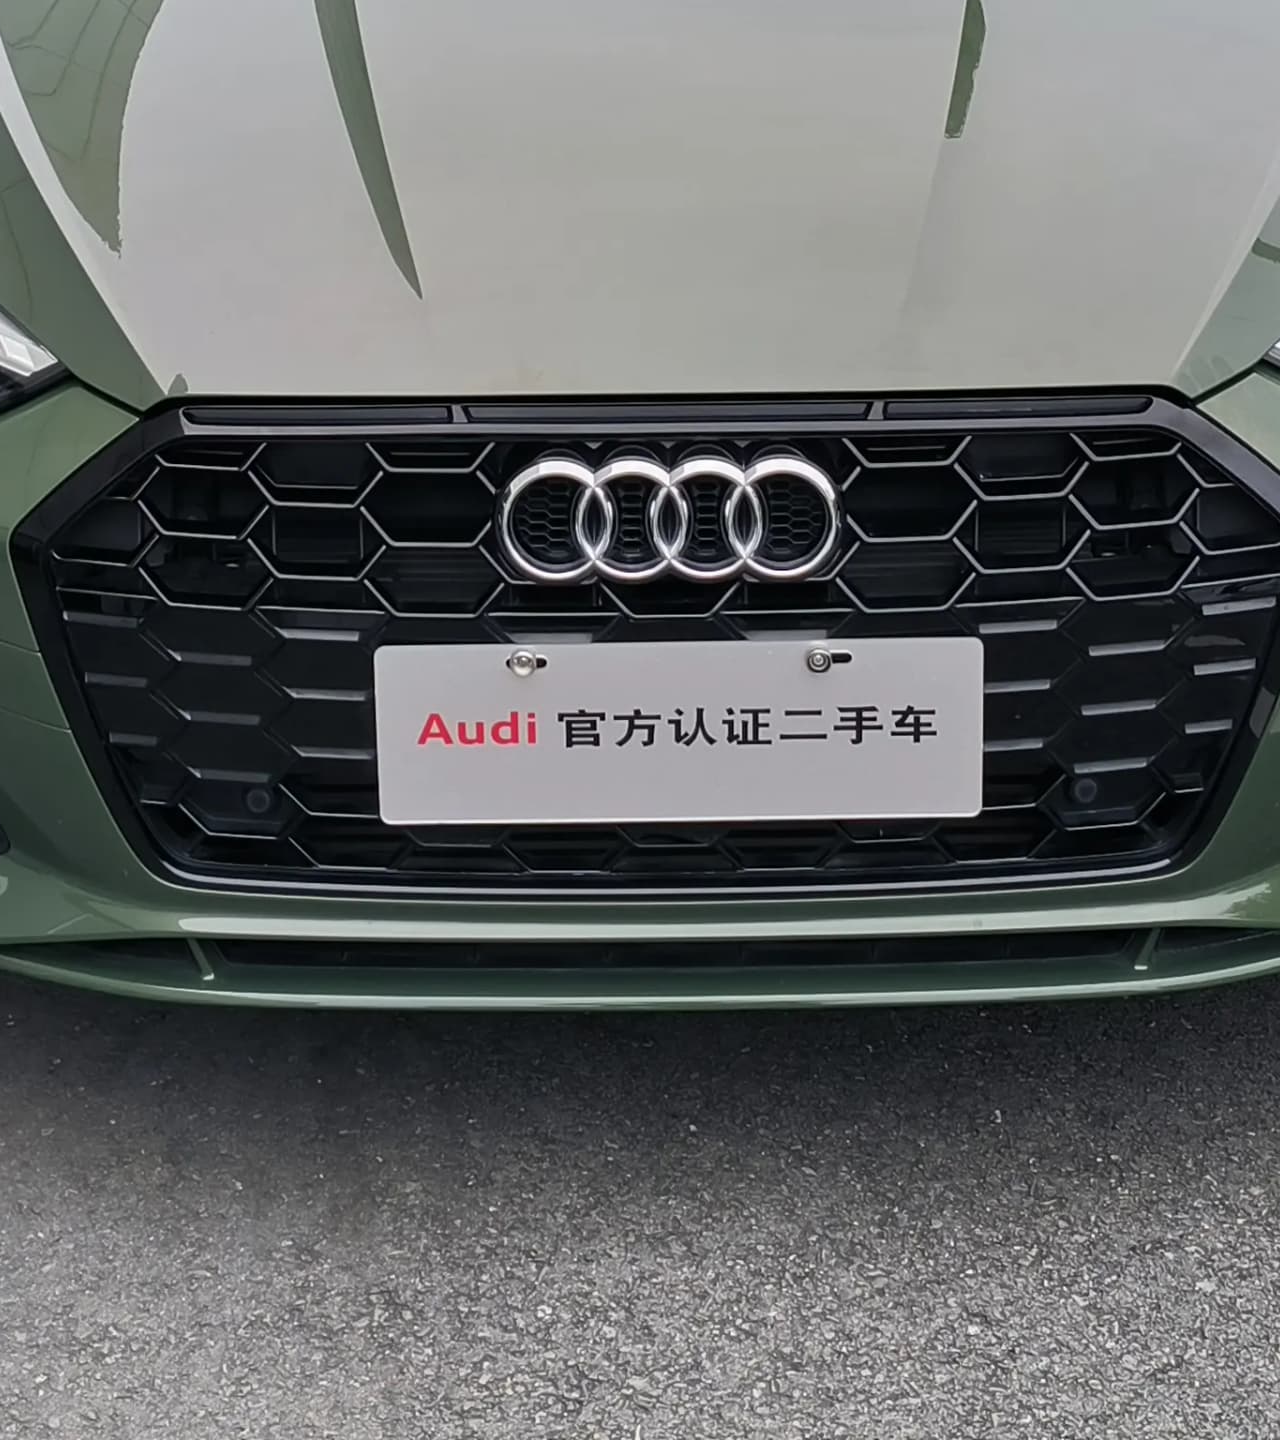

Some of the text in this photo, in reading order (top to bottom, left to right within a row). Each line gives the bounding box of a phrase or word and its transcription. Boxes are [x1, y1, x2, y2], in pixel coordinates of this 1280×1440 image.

[417, 705, 938, 748] Audi 官方认证二手车
